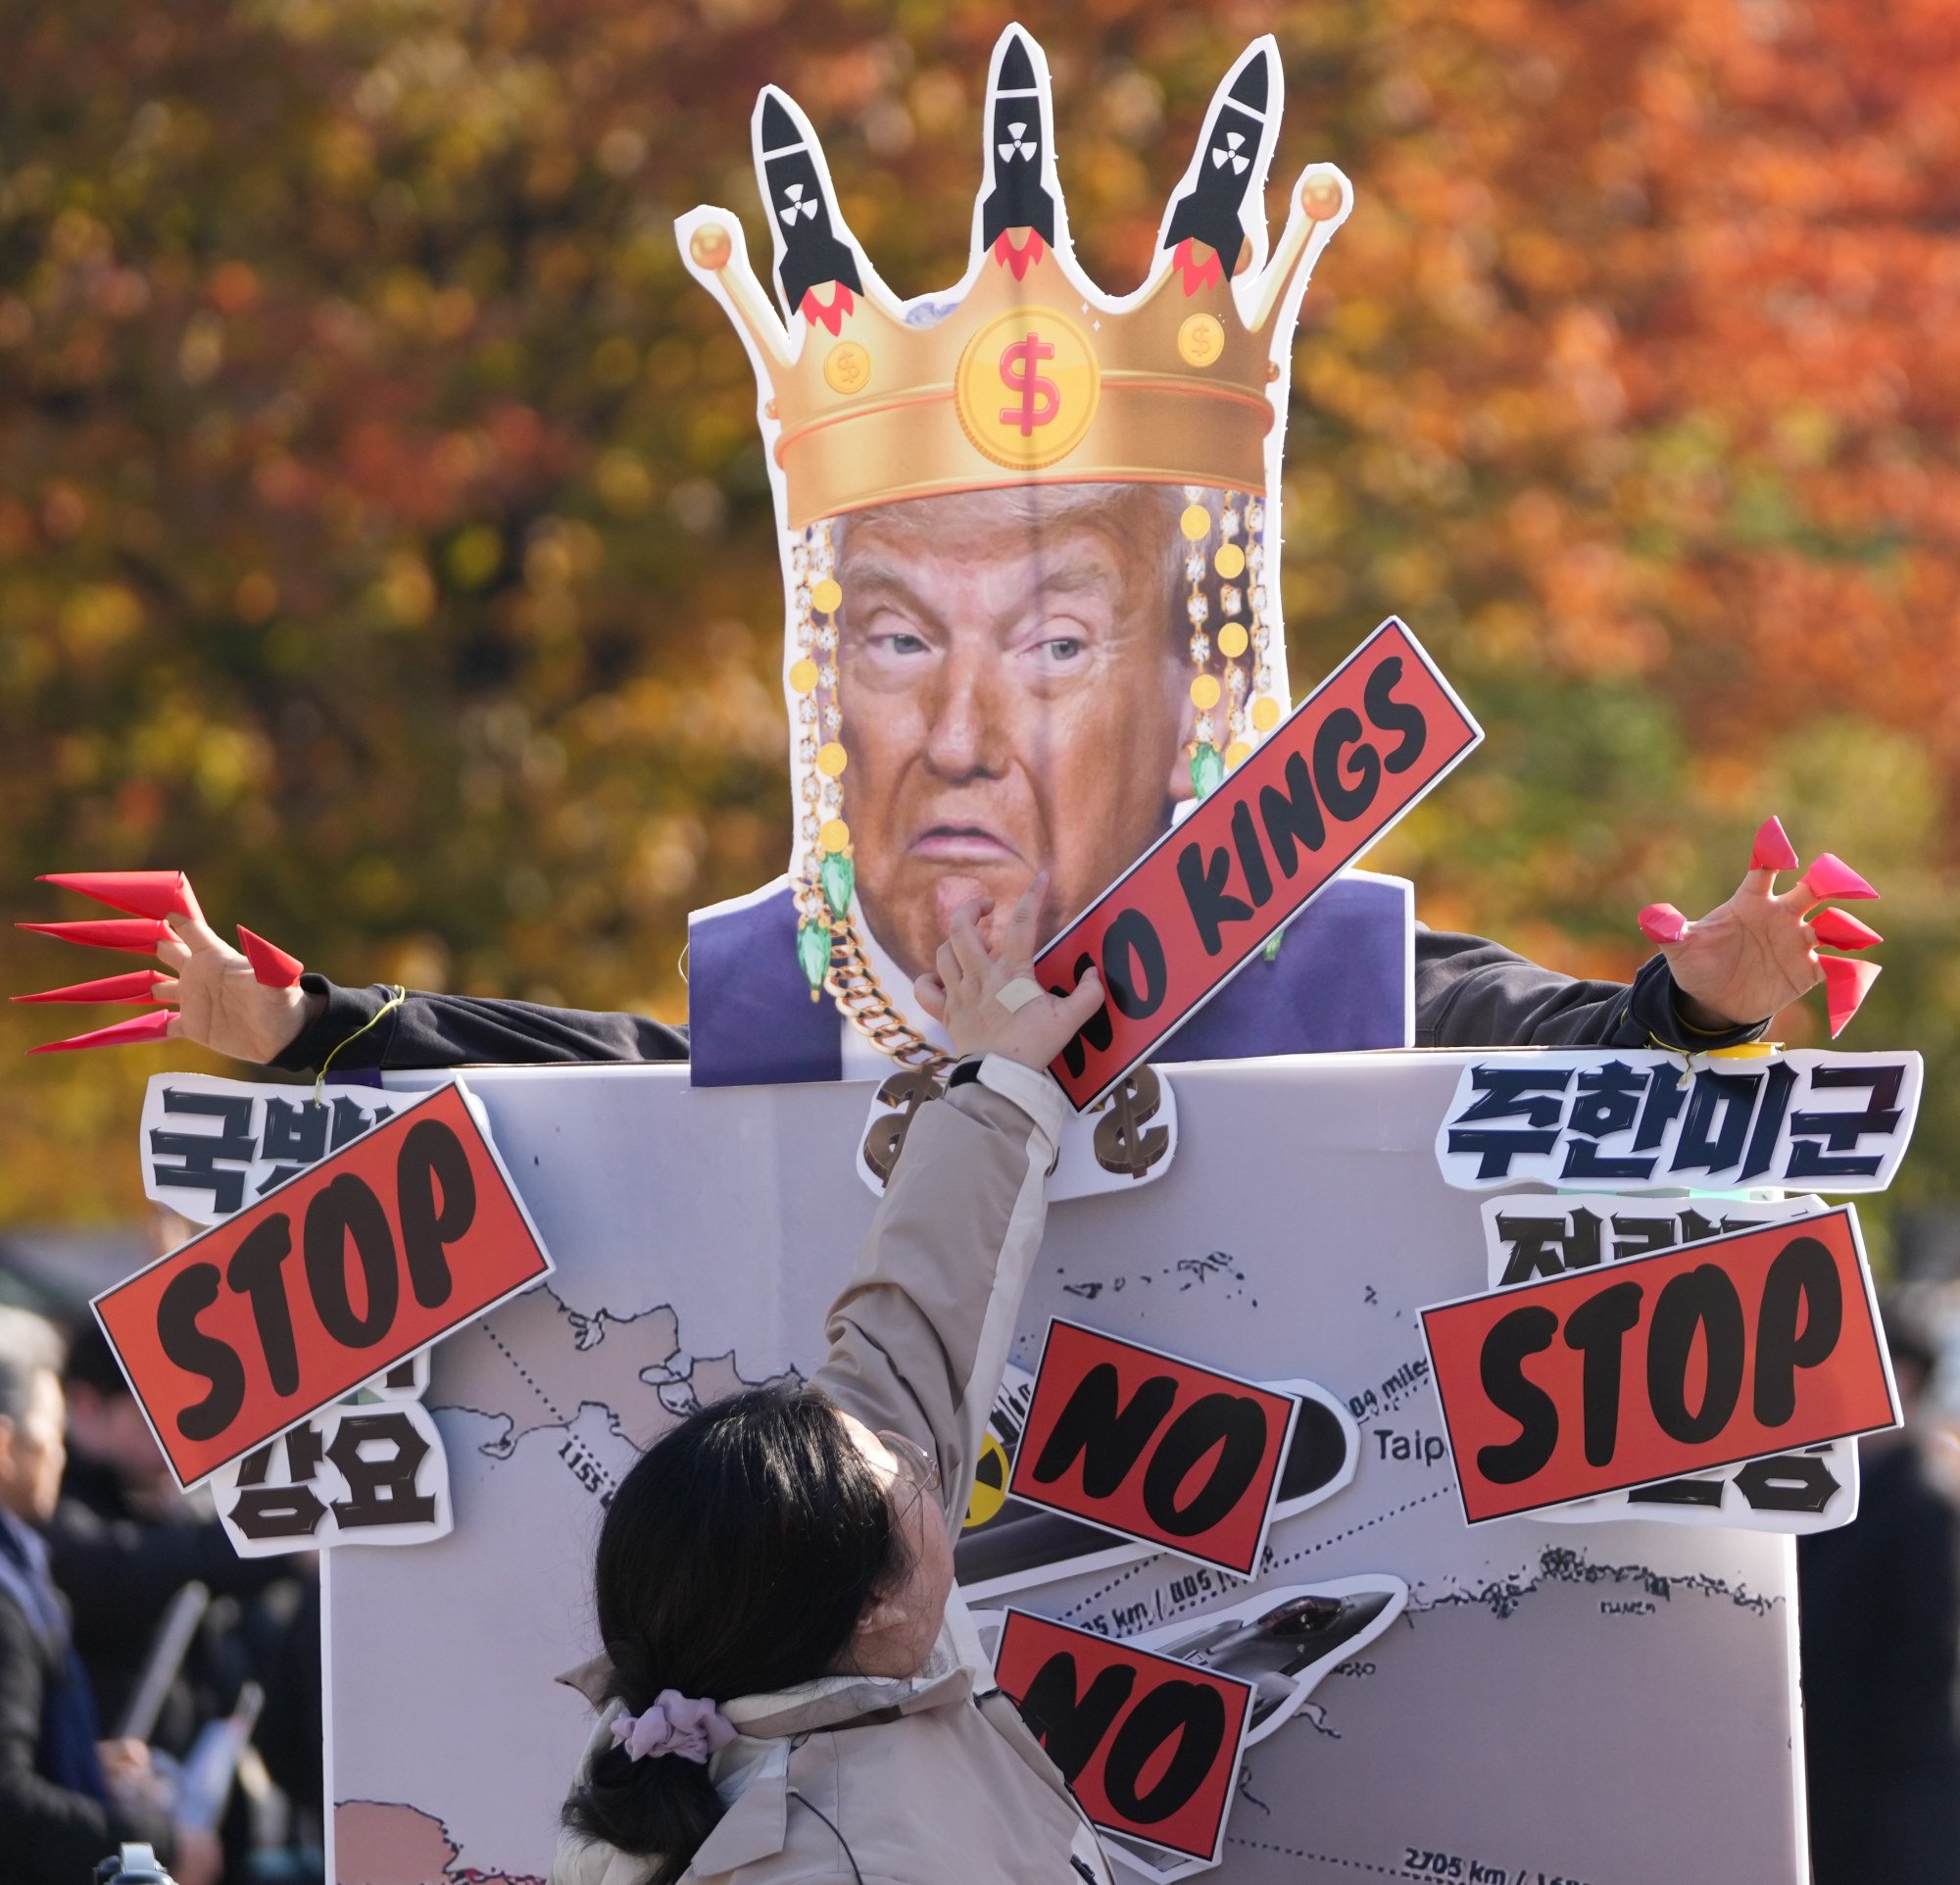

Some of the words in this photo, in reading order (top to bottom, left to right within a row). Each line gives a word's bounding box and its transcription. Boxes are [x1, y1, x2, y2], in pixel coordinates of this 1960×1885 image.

[1178, 656, 1427, 957] KINGS
[149, 1086, 396, 1214] 국방
[1446, 1059, 1907, 1184] 주한미군
[157, 1119, 476, 1441] STOP
[1382, 1356, 1430, 1400] mile
[1476, 1237, 1842, 1485] STOP
[1032, 1362, 1267, 1538] NO
[1373, 1429, 1449, 1467] Taip
[1017, 1651, 1226, 1825] NO
[1404, 1847, 1463, 1878] 2705
